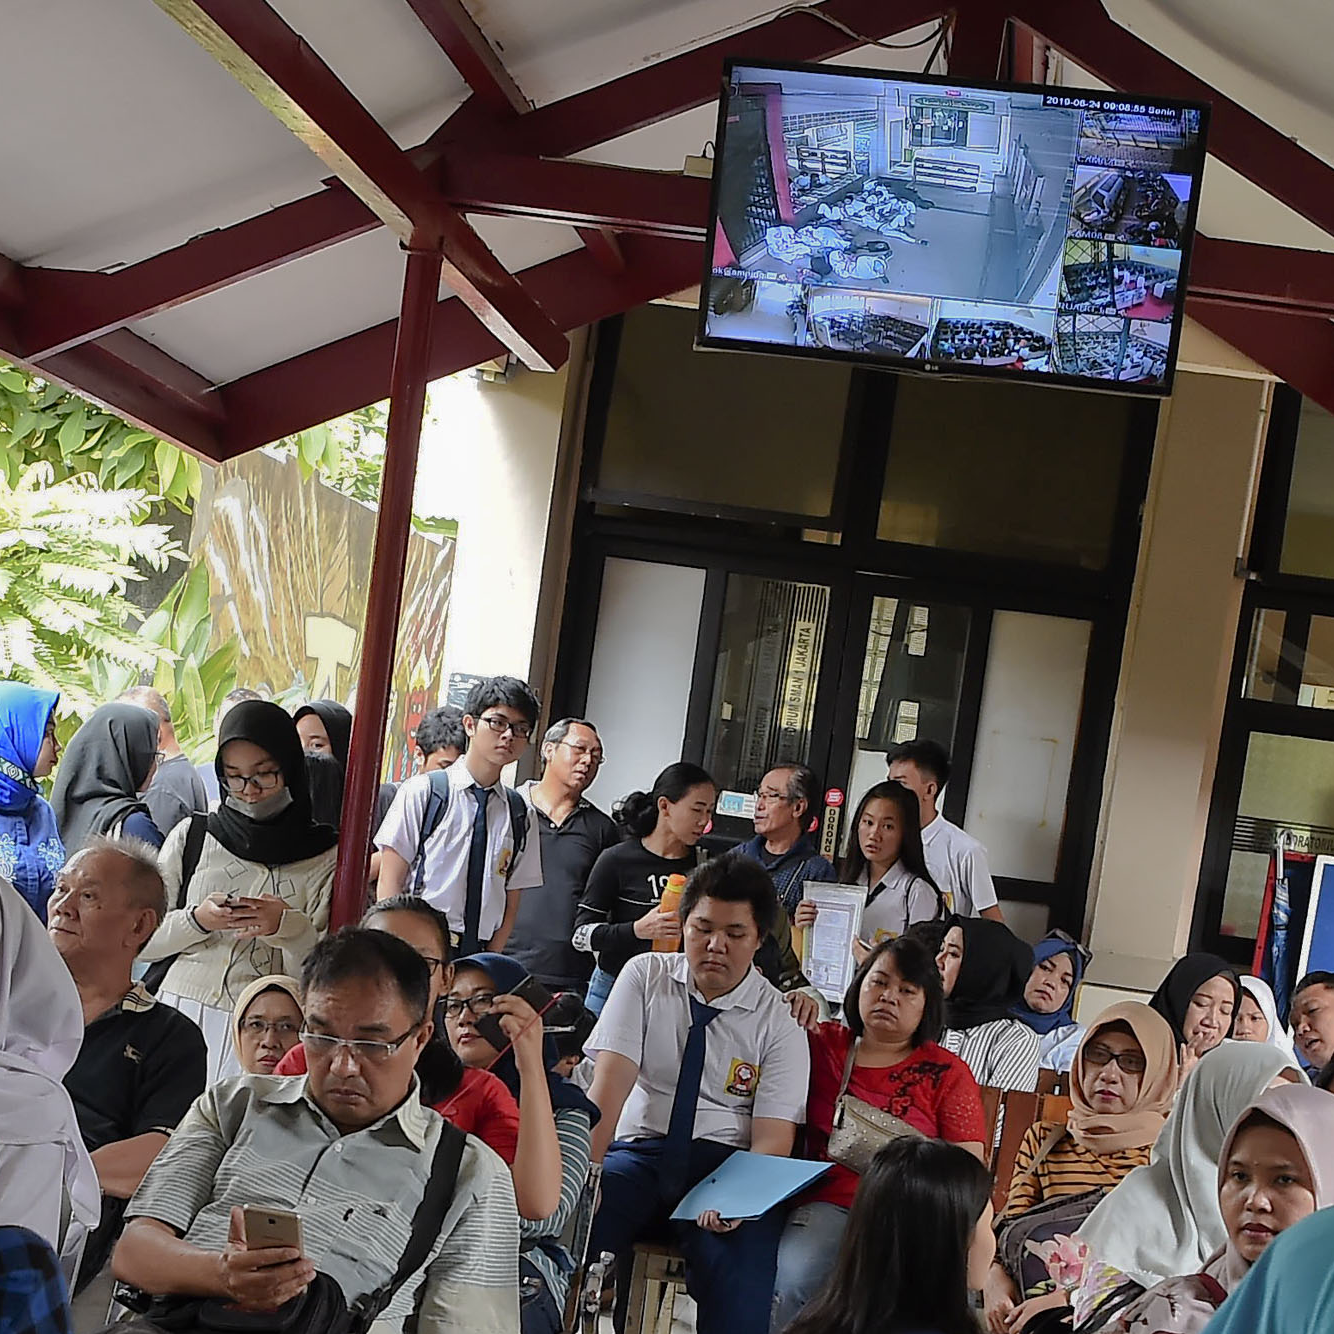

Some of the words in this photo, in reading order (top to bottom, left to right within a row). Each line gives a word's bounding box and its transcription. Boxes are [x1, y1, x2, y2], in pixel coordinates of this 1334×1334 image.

[794, 627, 812, 667] JAKARTA
[789, 677, 804, 702] SMAN
[824, 808, 837, 853] DORONG
